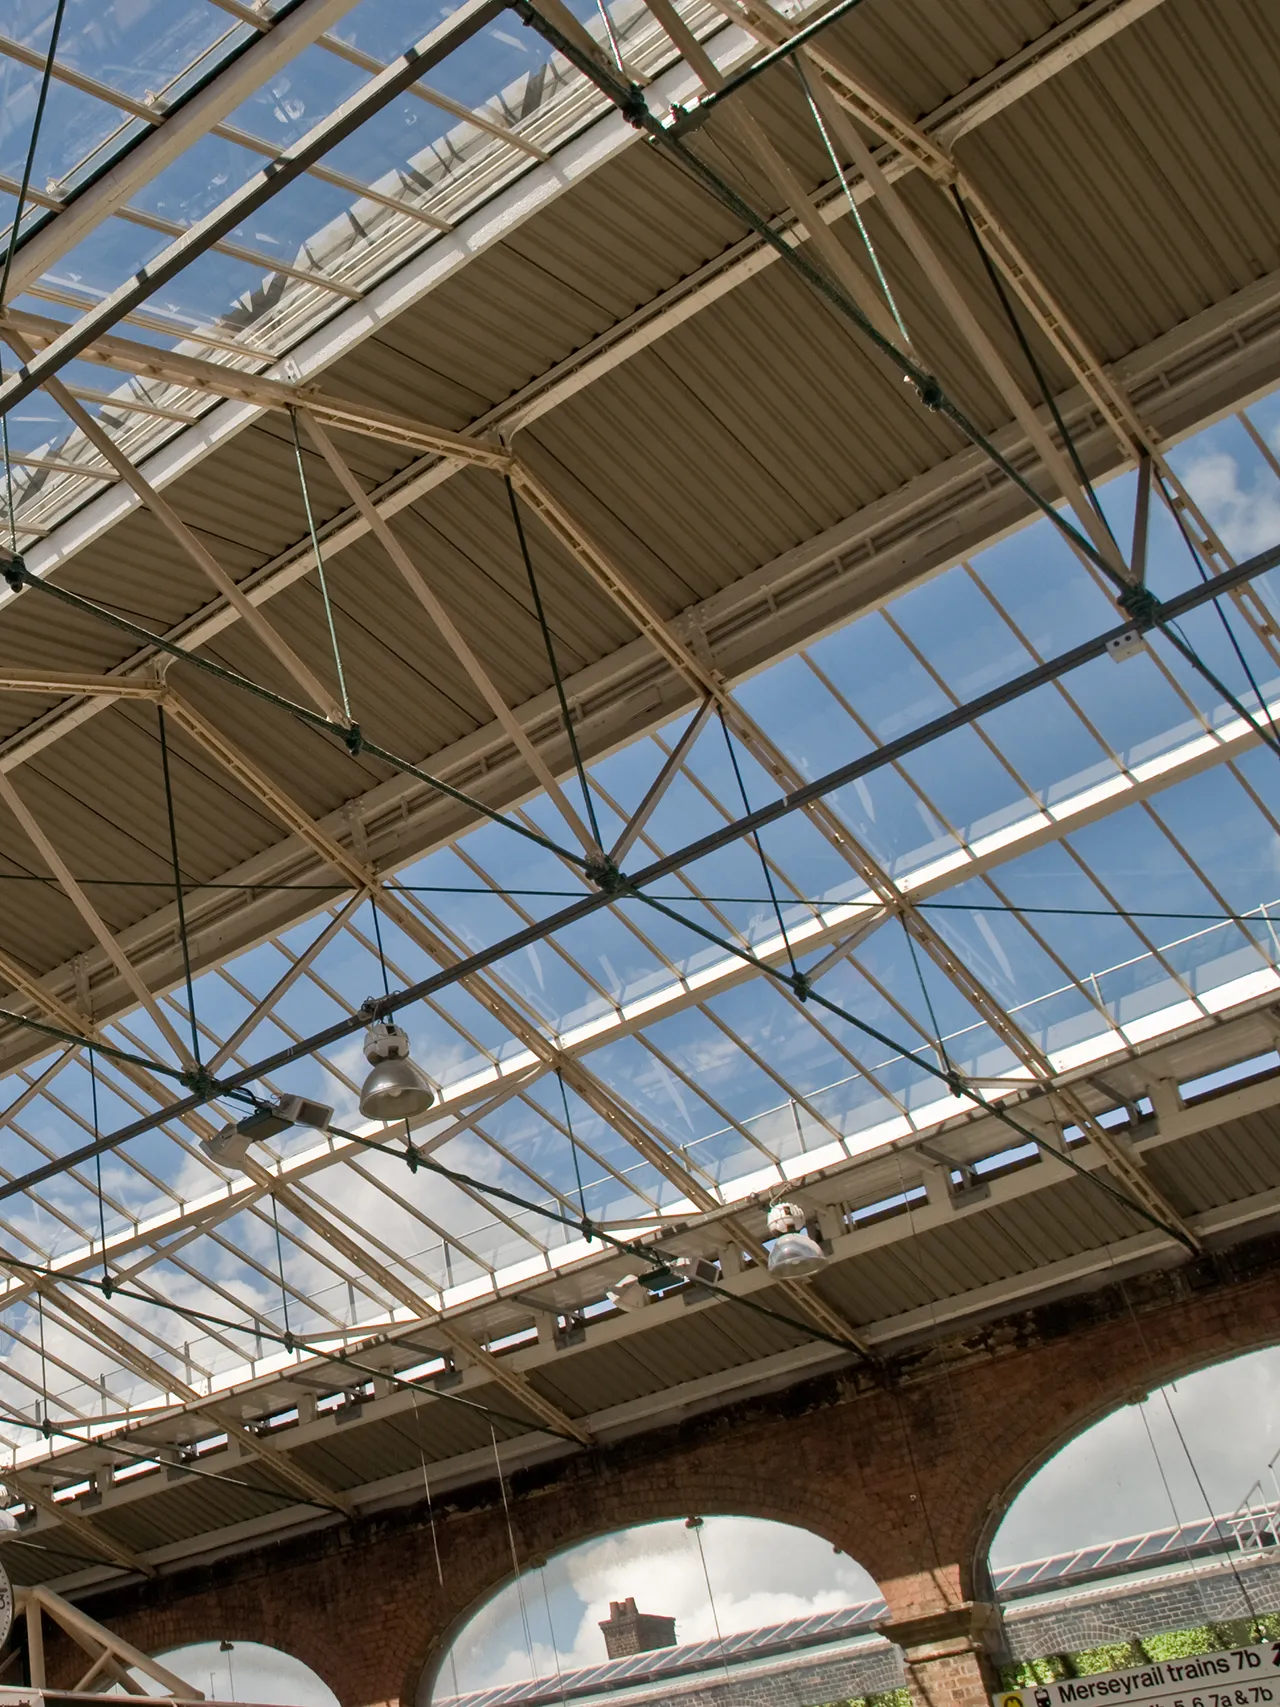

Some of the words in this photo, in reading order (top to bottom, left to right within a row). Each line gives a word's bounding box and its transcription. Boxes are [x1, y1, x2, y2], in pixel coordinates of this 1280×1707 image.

[1057, 1665, 1166, 1703] Merseyrail
[1167, 1658, 1230, 1682] trains
[1230, 1649, 1261, 1670] 7b
[1208, 1694, 1232, 1707] 7a
[1234, 1690, 1249, 1705] &
[1248, 1686, 1273, 1703] 7b
